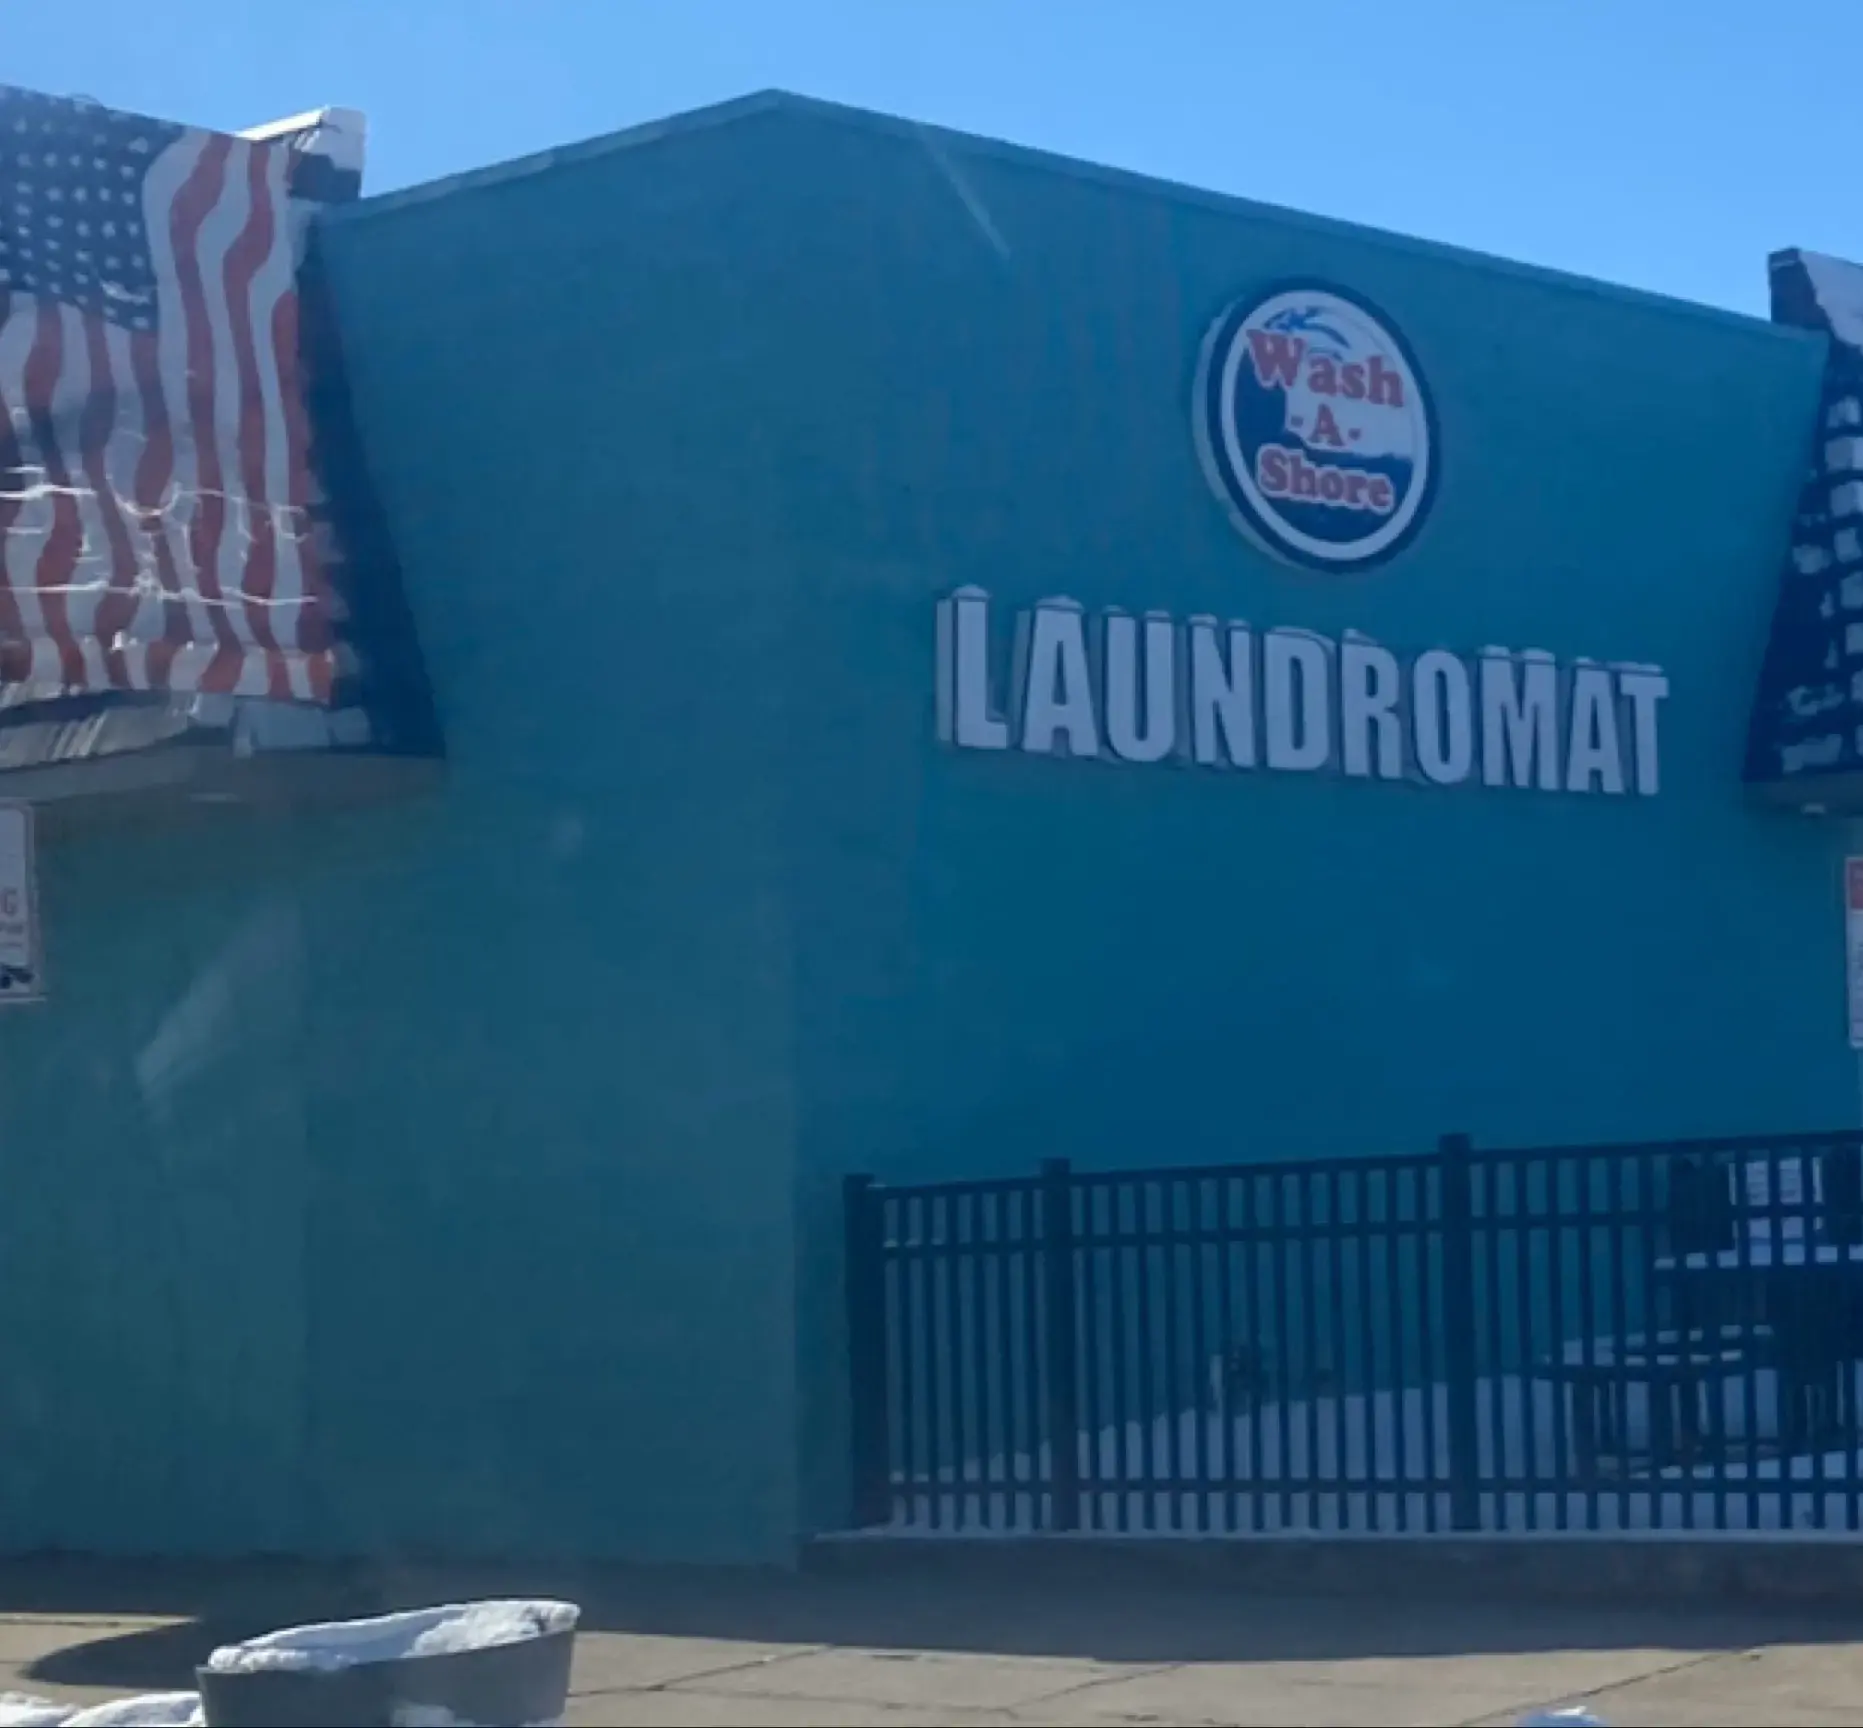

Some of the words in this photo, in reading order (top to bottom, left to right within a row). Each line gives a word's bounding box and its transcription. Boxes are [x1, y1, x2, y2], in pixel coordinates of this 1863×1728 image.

[1246, 327, 1405, 408] Wash
[1258, 446, 1394, 510] Shore
[937, 586, 1668, 796] LAUNDROMAT
